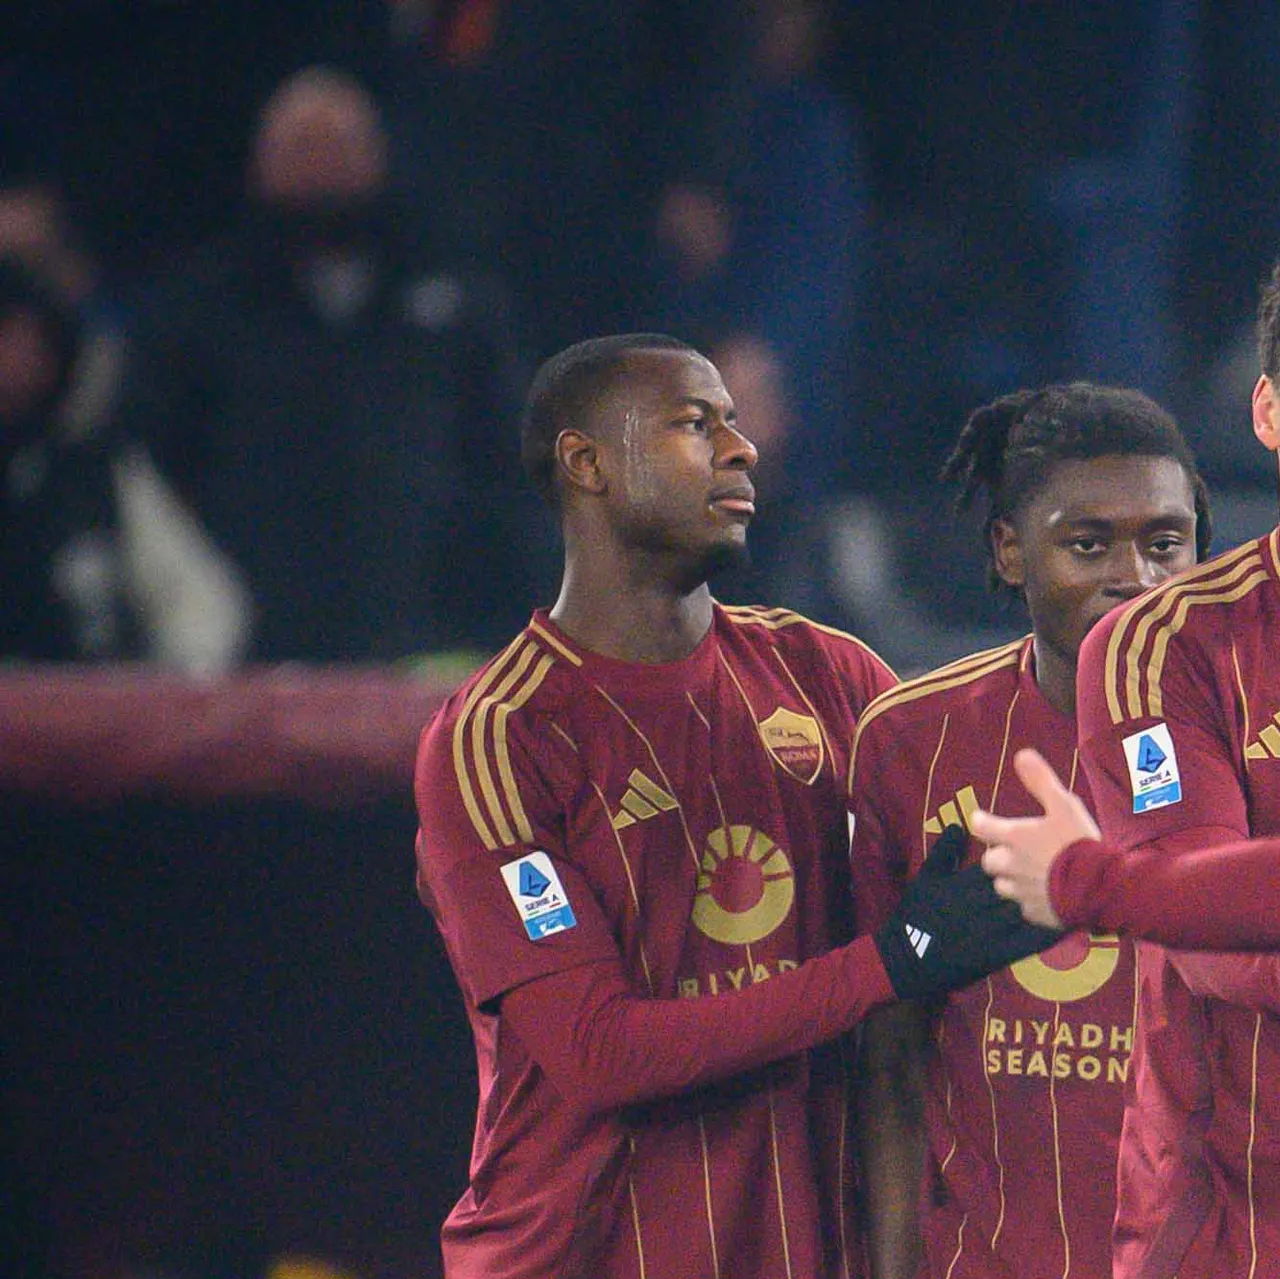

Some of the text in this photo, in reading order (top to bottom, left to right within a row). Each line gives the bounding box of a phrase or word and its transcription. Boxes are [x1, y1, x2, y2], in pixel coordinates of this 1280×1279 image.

[682, 959, 799, 997] RIYA
[988, 1017, 1133, 1050] RIYADH
[988, 1049, 1130, 1083] SEASON
